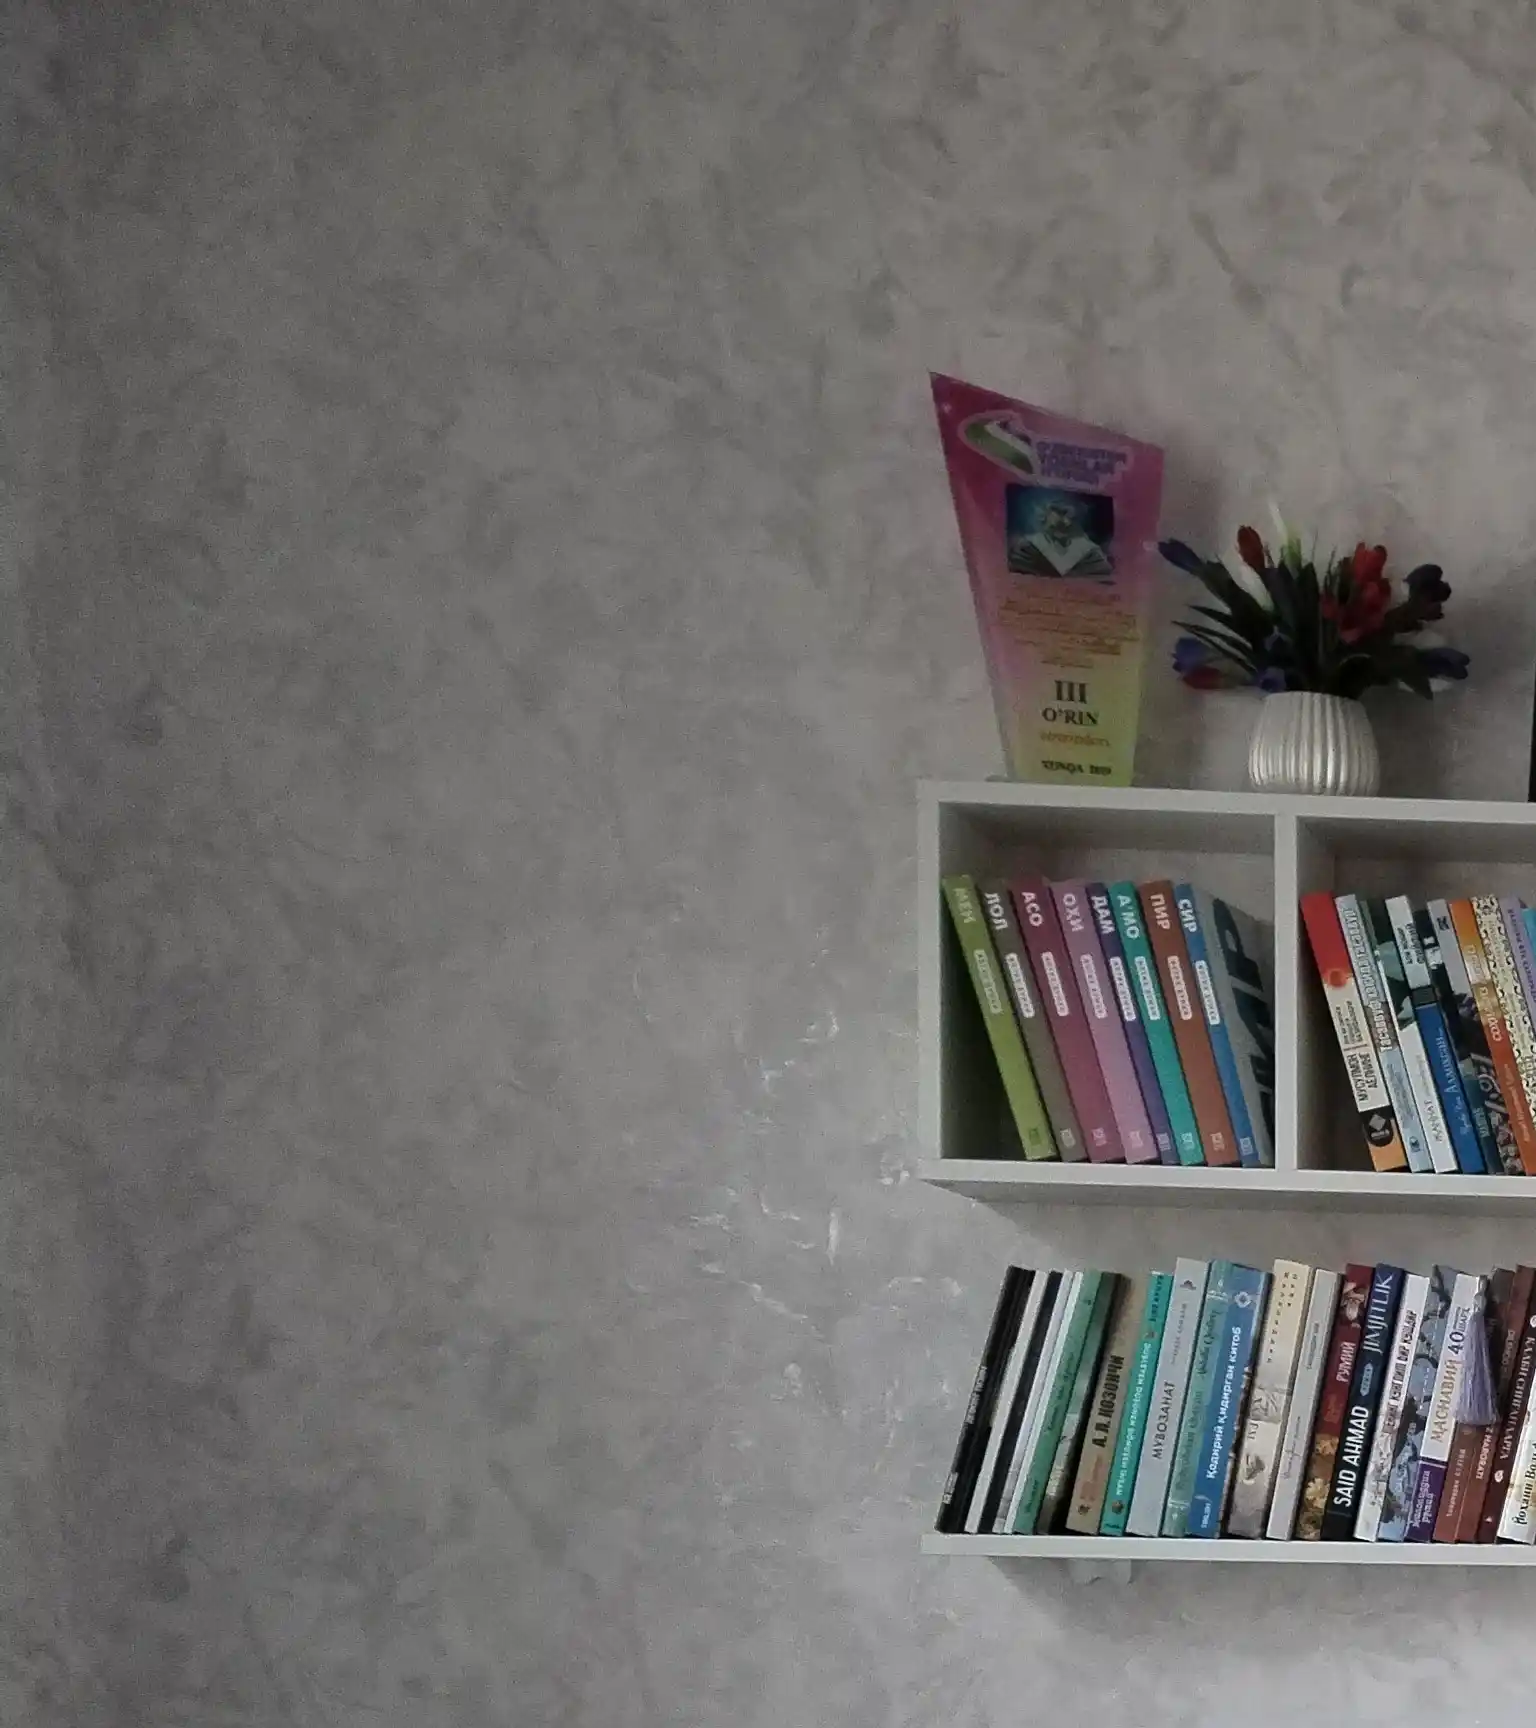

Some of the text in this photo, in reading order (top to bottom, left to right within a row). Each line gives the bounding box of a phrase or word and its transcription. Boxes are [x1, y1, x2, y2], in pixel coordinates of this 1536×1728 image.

[1055, 680, 1087, 704] III
[1042, 706, 1099, 727] O'RIN
[1021, 890, 1043, 928] АСО
[1091, 895, 1115, 935] ДАМ
[1149, 892, 1172, 931] ПИР
[1177, 898, 1198, 933] СИР
[1363, 1271, 1395, 1353] JIMJITLIK
[1335, 1340, 1358, 1383] РУМИЙ
[1204, 1325, 1243, 1480] Қодирий қидирган китоб
[1429, 1331, 1466, 1444] МАСНАВИЙ 40
[1151, 1381, 1176, 1460] МУВОЗАНАТ
[1333, 1404, 1371, 1508] SAID AHMAD
[1511, 1482, 1535, 1527] Йоханн
